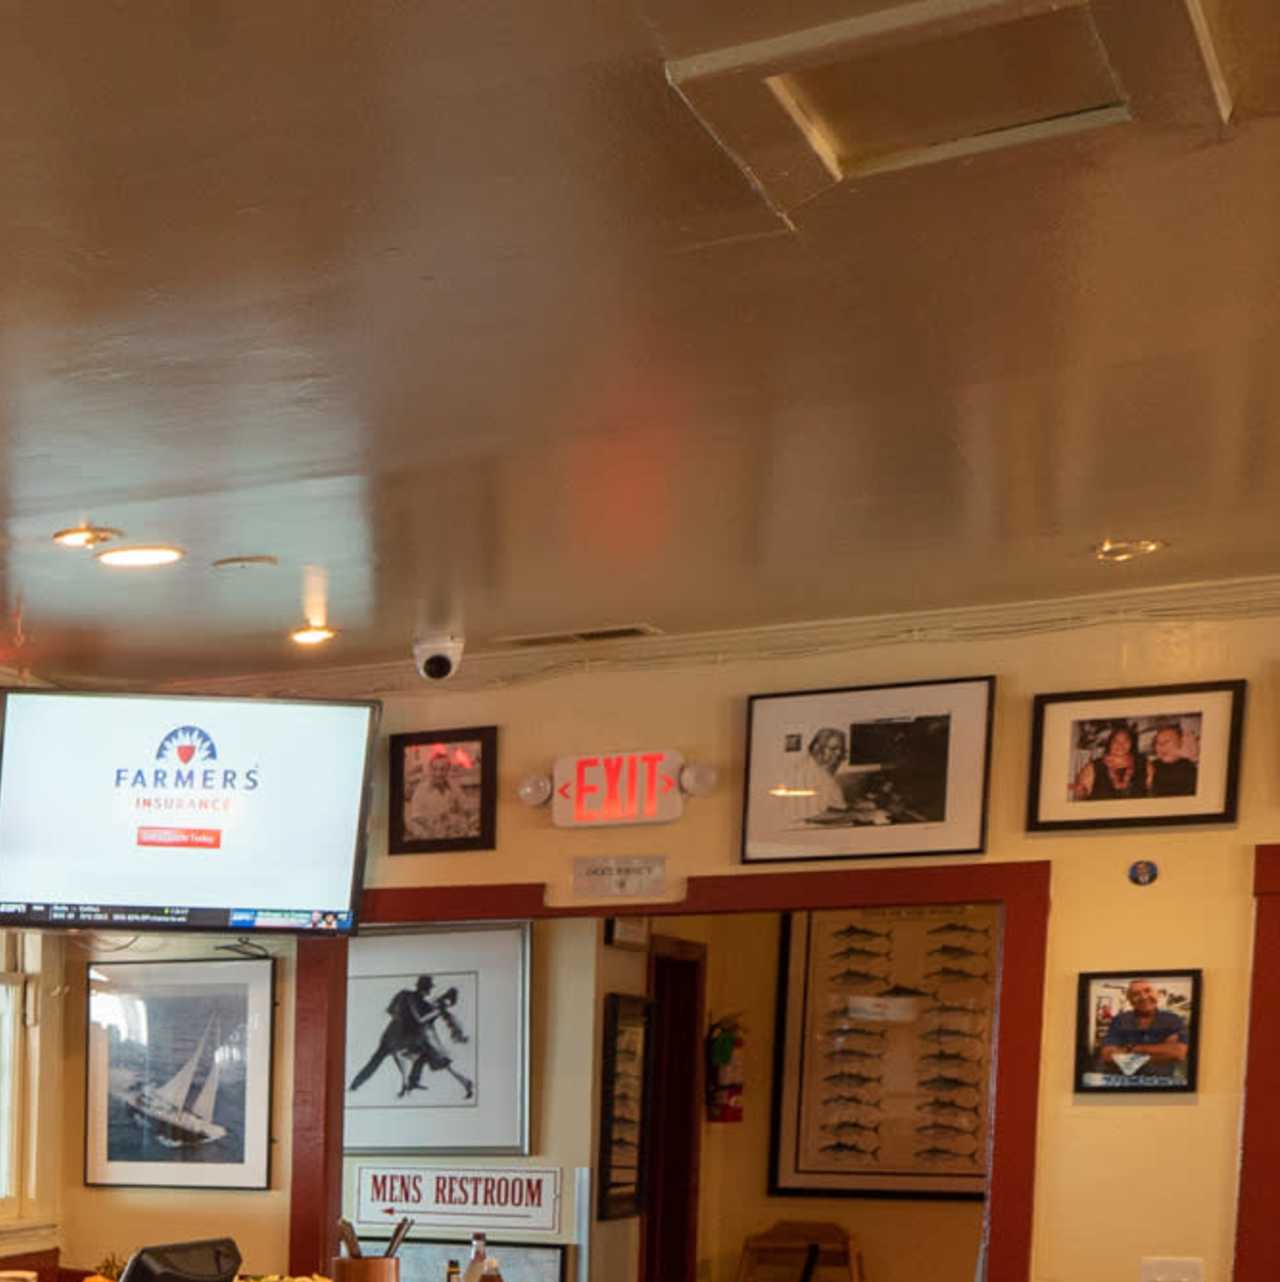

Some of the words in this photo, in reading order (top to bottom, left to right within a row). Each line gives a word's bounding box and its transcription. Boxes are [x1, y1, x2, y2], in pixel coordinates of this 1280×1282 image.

[114, 767, 259, 791] FARMERS
[573, 752, 667, 823] EXIT
[135, 796, 231, 811] INSURANCE
[370, 1173, 423, 1204] MENS
[434, 1175, 543, 1209] RESTROOM
